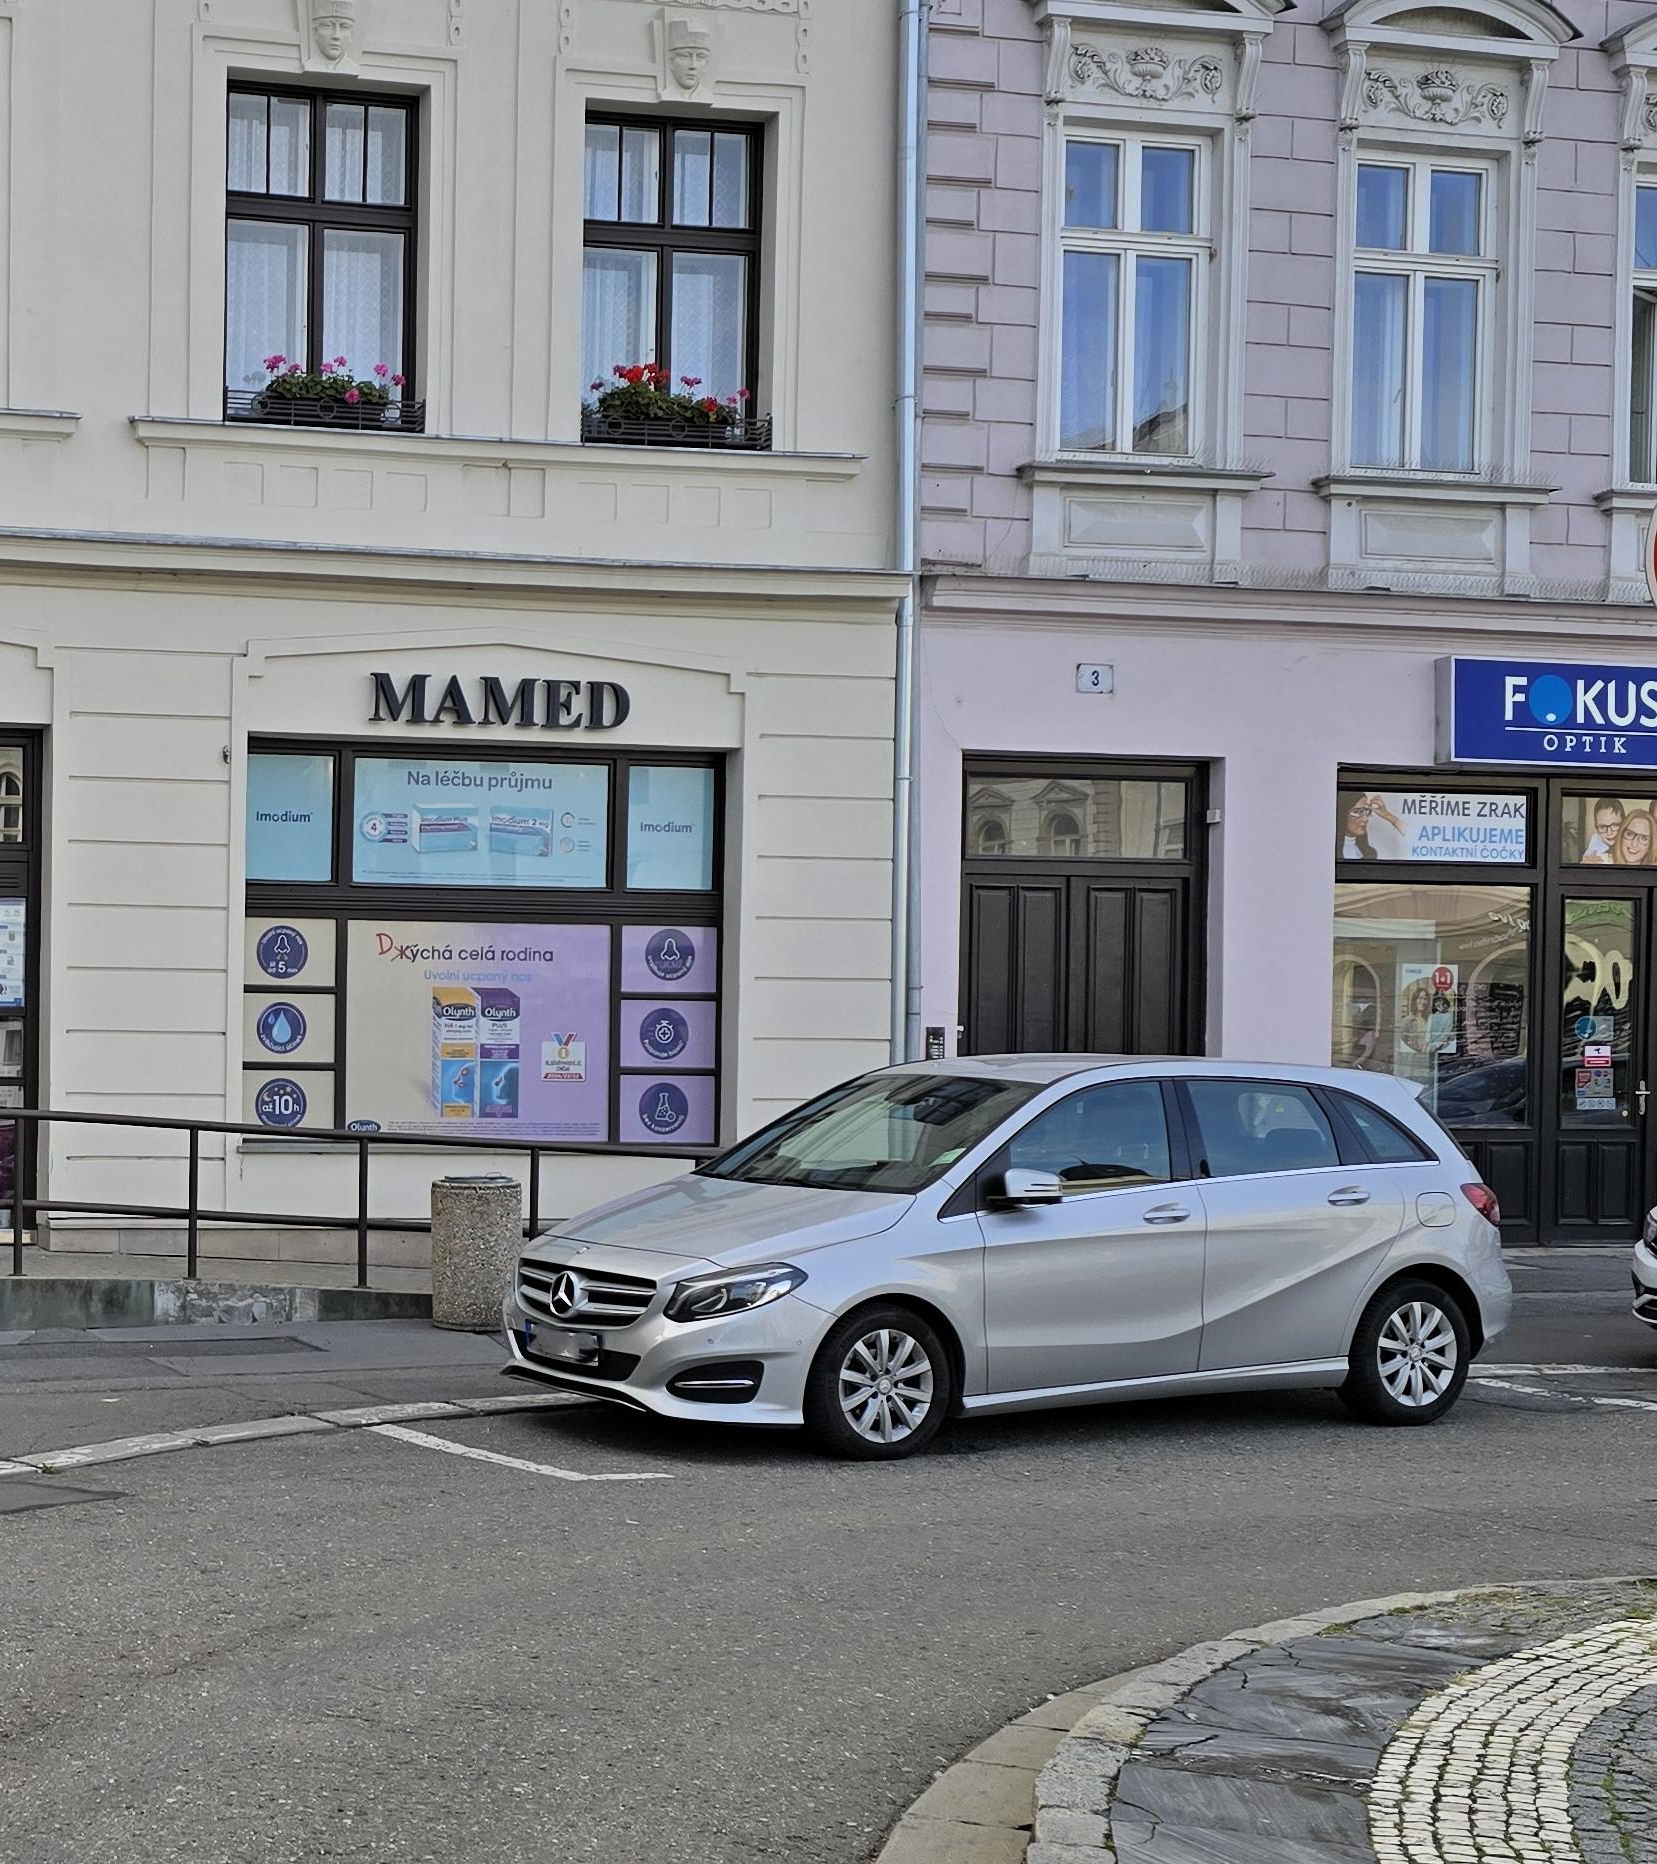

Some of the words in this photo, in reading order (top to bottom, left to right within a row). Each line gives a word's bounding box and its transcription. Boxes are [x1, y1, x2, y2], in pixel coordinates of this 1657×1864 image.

[1091, 670, 1100, 687] 3
[368, 672, 631, 730] MAMED
[1543, 734, 1627, 754] OPTIK
[407, 770, 431, 786] Na
[435, 770, 484, 787] léčbu
[488, 771, 553, 792] průjmu
[1401, 795, 1471, 817] MĚŘÍME
[1476, 801, 1525, 818] ZRAK
[256, 810, 311, 823] Imodium
[532, 818, 538, 826] 2
[640, 821, 693, 833] Imodium
[1417, 825, 1524, 845] APLIKUJEME
[1411, 845, 1477, 858] KONTAKTNÍ
[1480, 846, 1525, 859] ČOČKY
[458, 945, 496, 961] celá
[500, 947, 554, 962] rodina
[278, 961, 286, 973] 5
[423, 969, 460, 981] Uvolní
[462, 971, 508, 984] ucpaný
[510, 973, 533, 982] nos
[443, 1006, 475, 1018] Olynth
[484, 1007, 516, 1018] Olynth
[262, 1103, 273, 1112] až
[273, 1095, 293, 1115] 10
[294, 1103, 300, 1112] h
[350, 1122, 378, 1132] Olynth
